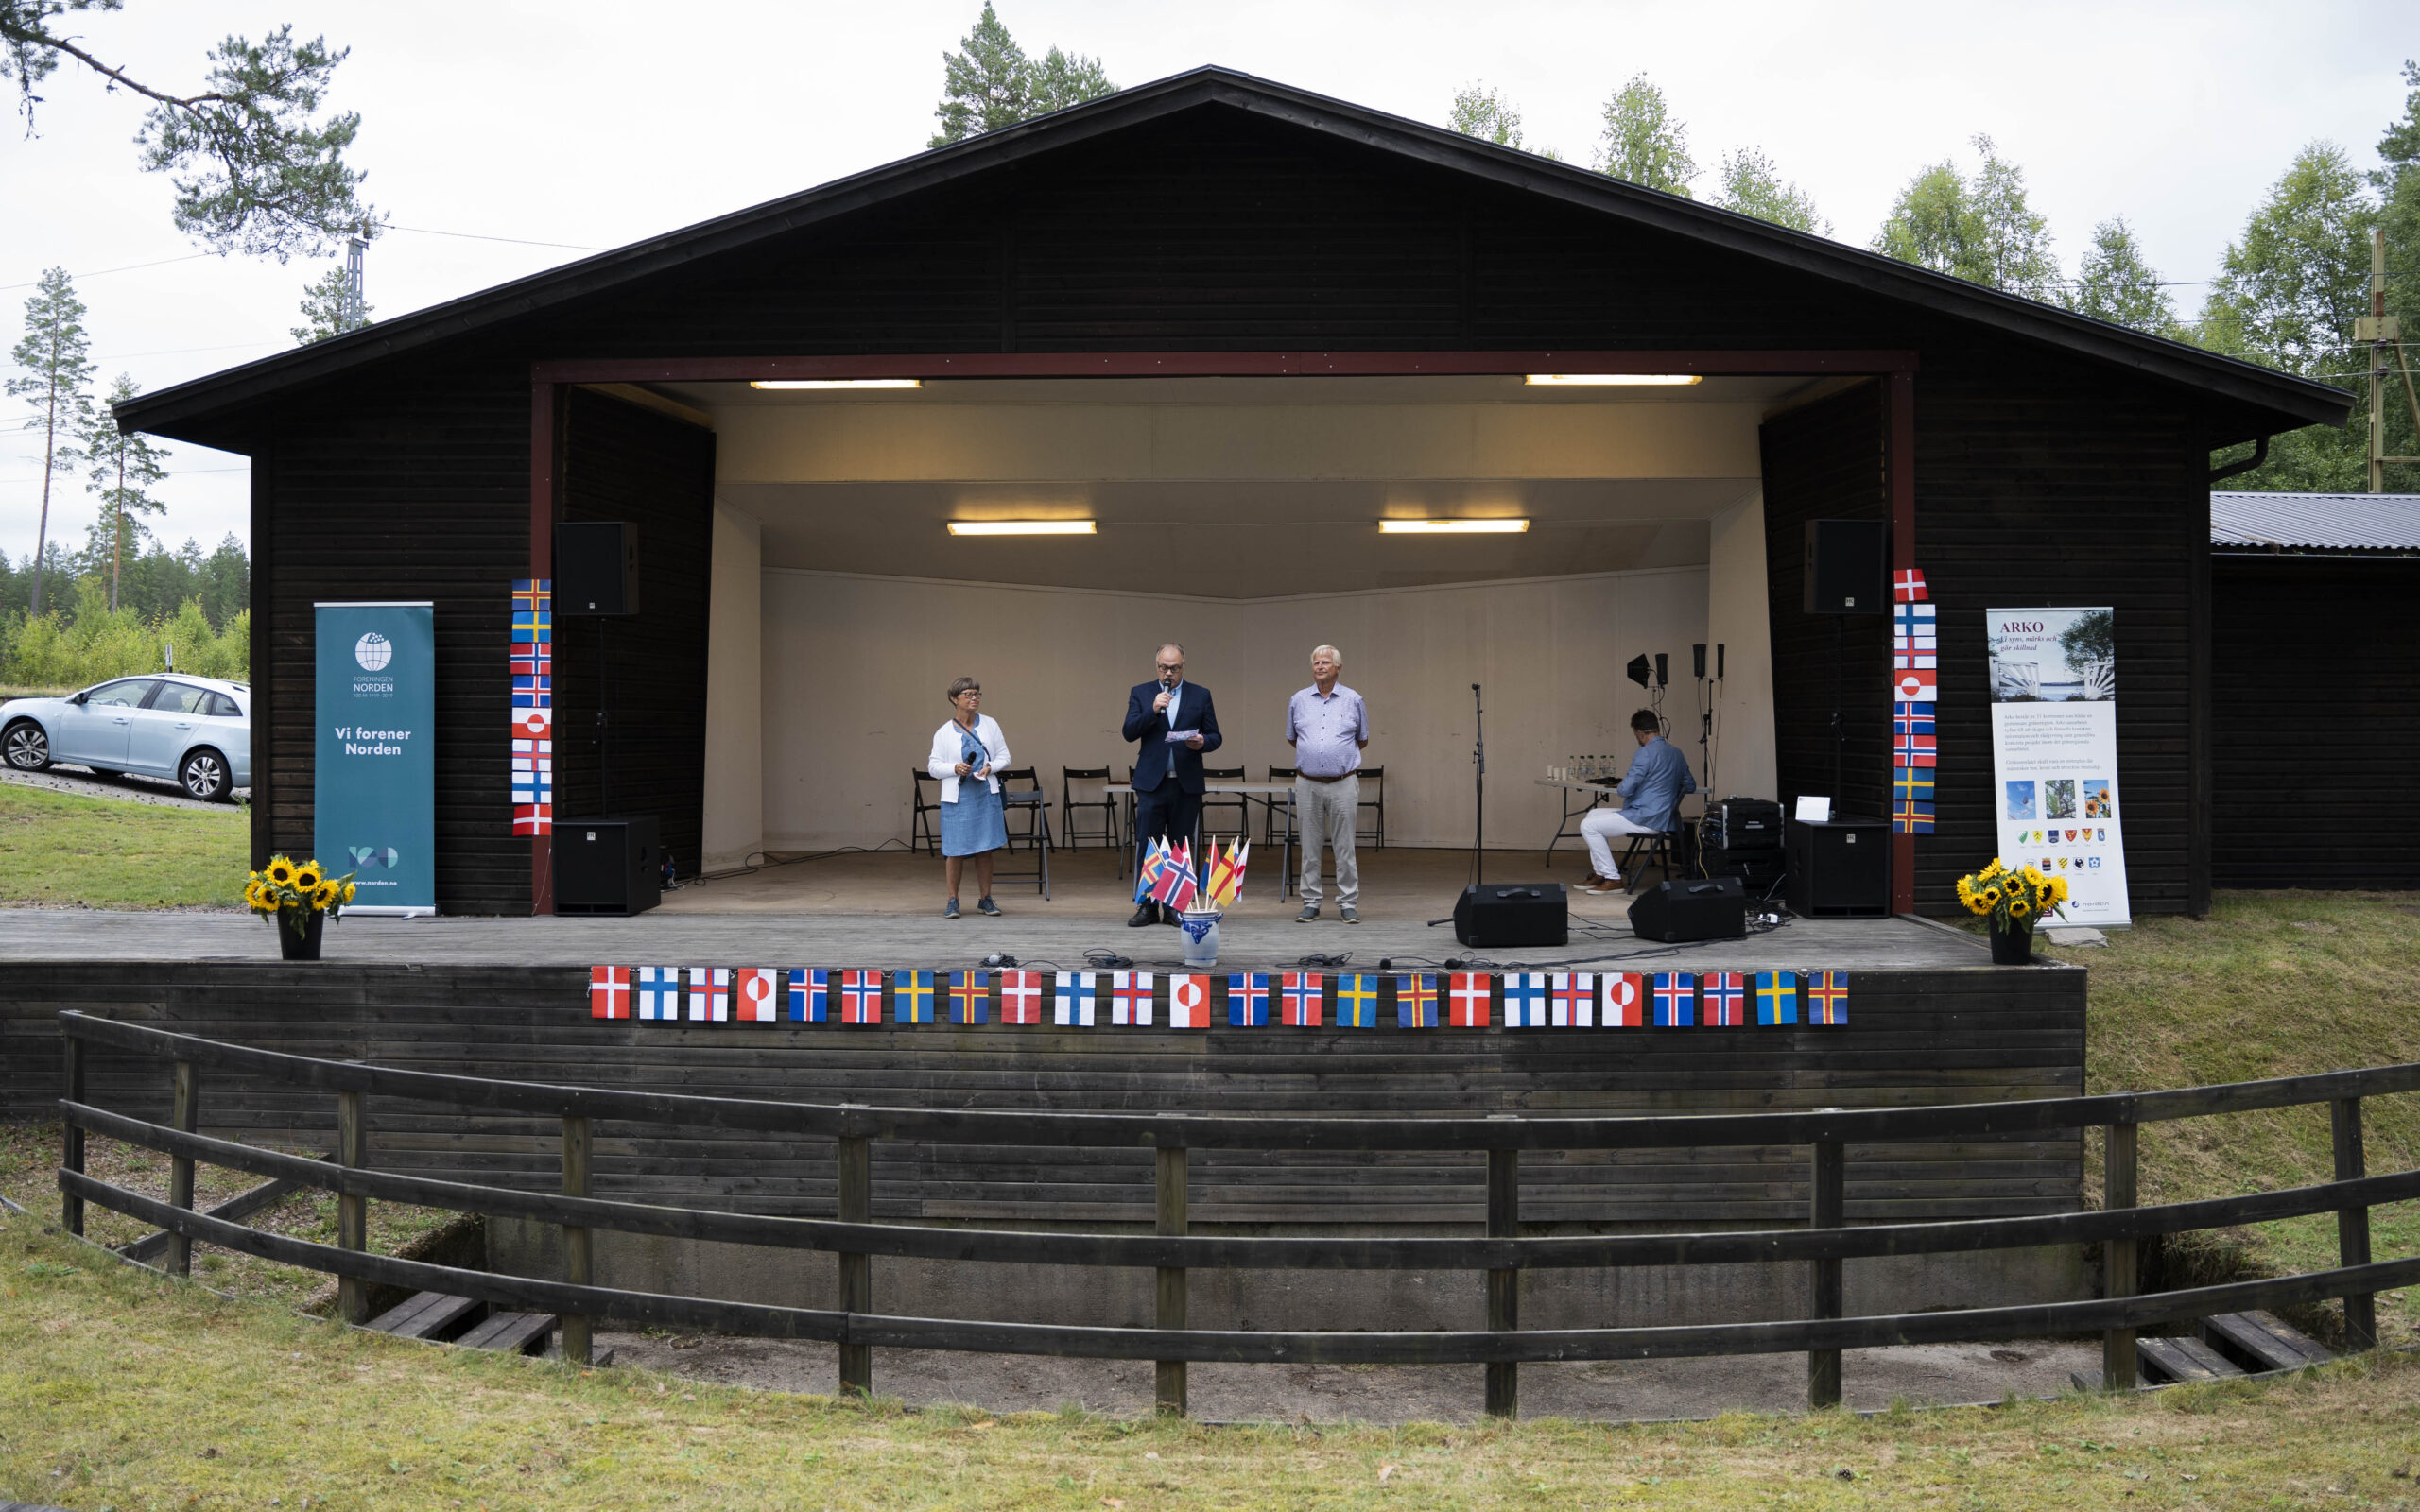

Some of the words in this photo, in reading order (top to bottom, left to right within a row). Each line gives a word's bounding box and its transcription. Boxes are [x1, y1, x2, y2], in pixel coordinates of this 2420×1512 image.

[2000, 621, 2044, 633] ARKO
[354, 683, 393, 692] NORDEN
[335, 727, 351, 739] Vi
[356, 726, 411, 740] forener
[345, 742, 401, 755] Norden
